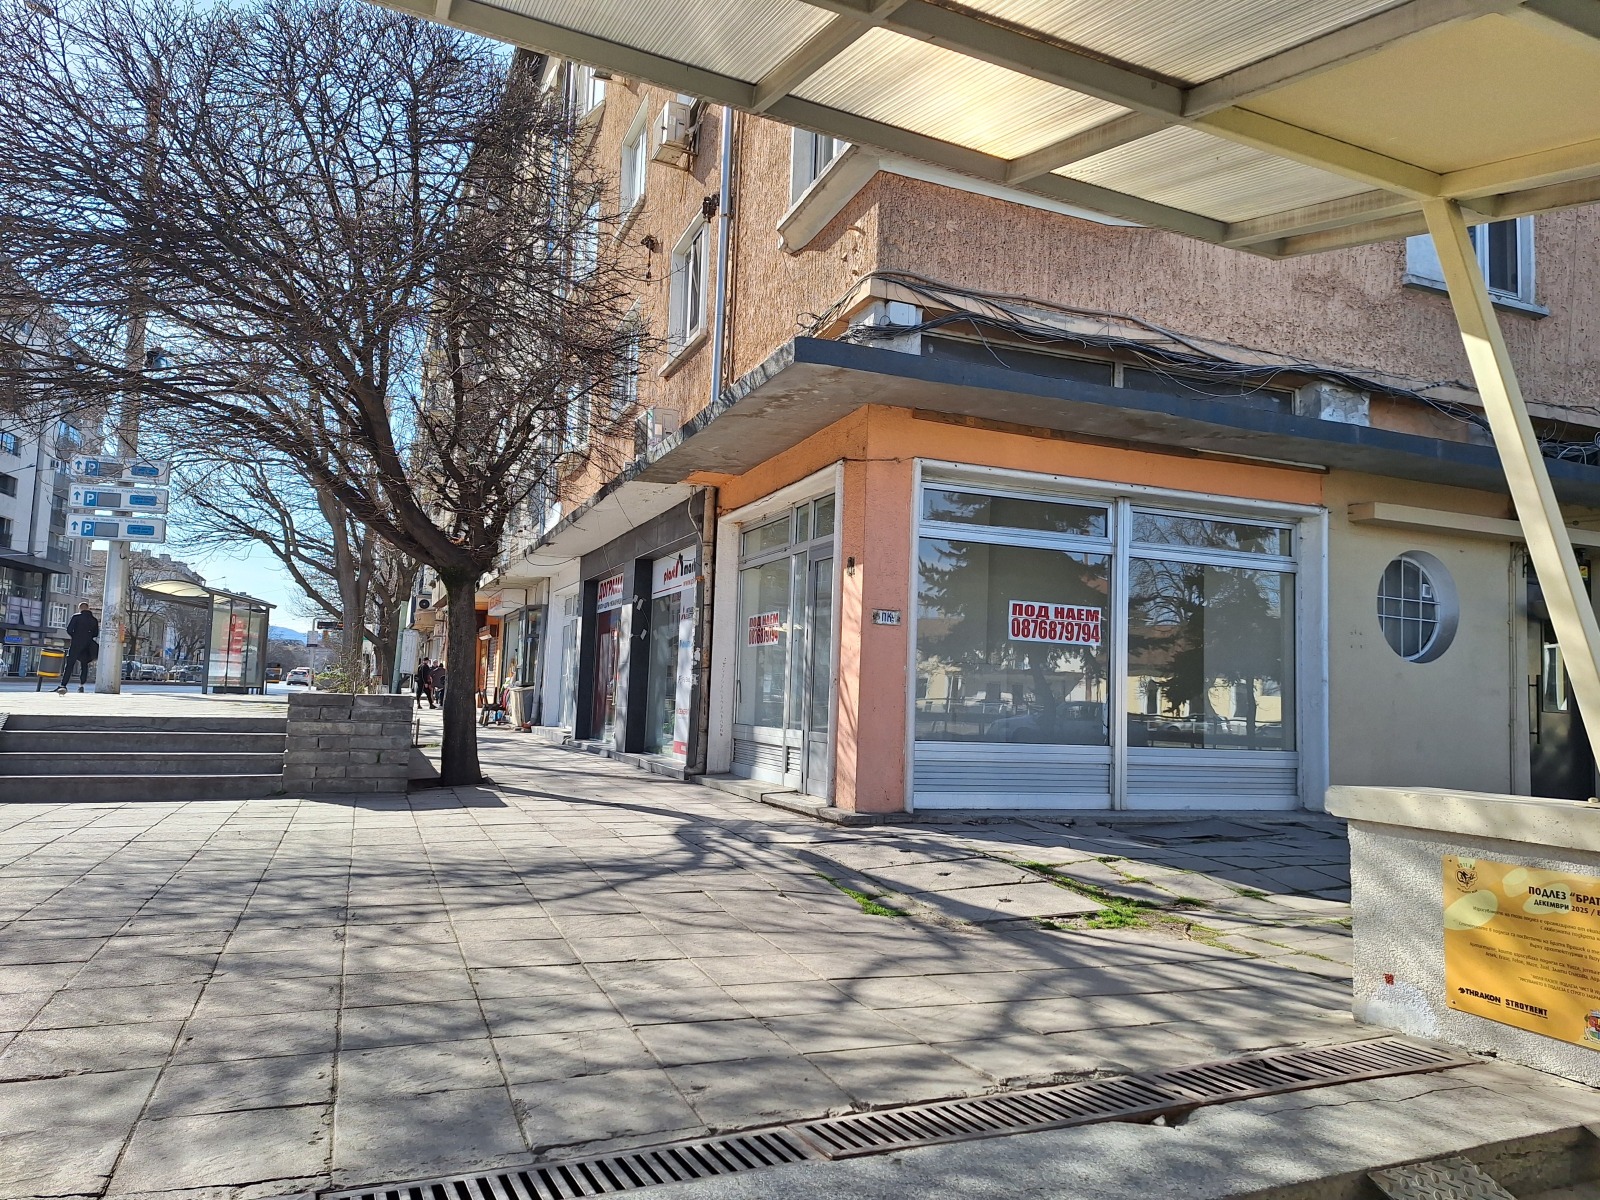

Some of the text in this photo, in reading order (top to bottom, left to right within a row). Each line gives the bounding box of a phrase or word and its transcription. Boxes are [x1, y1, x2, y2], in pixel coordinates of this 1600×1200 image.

[1012, 603, 1100, 622] ПОД НАЕМ
[1011, 618, 1100, 642] 0876879794
[1528, 886, 1567, 900] ПОДЛЕЗ
[1534, 899, 1570, 910] ДЕКЕМВРИ
[1571, 905, 1589, 914] 2025
[1465, 988, 1549, 1016] THRAKON STROYRENT
